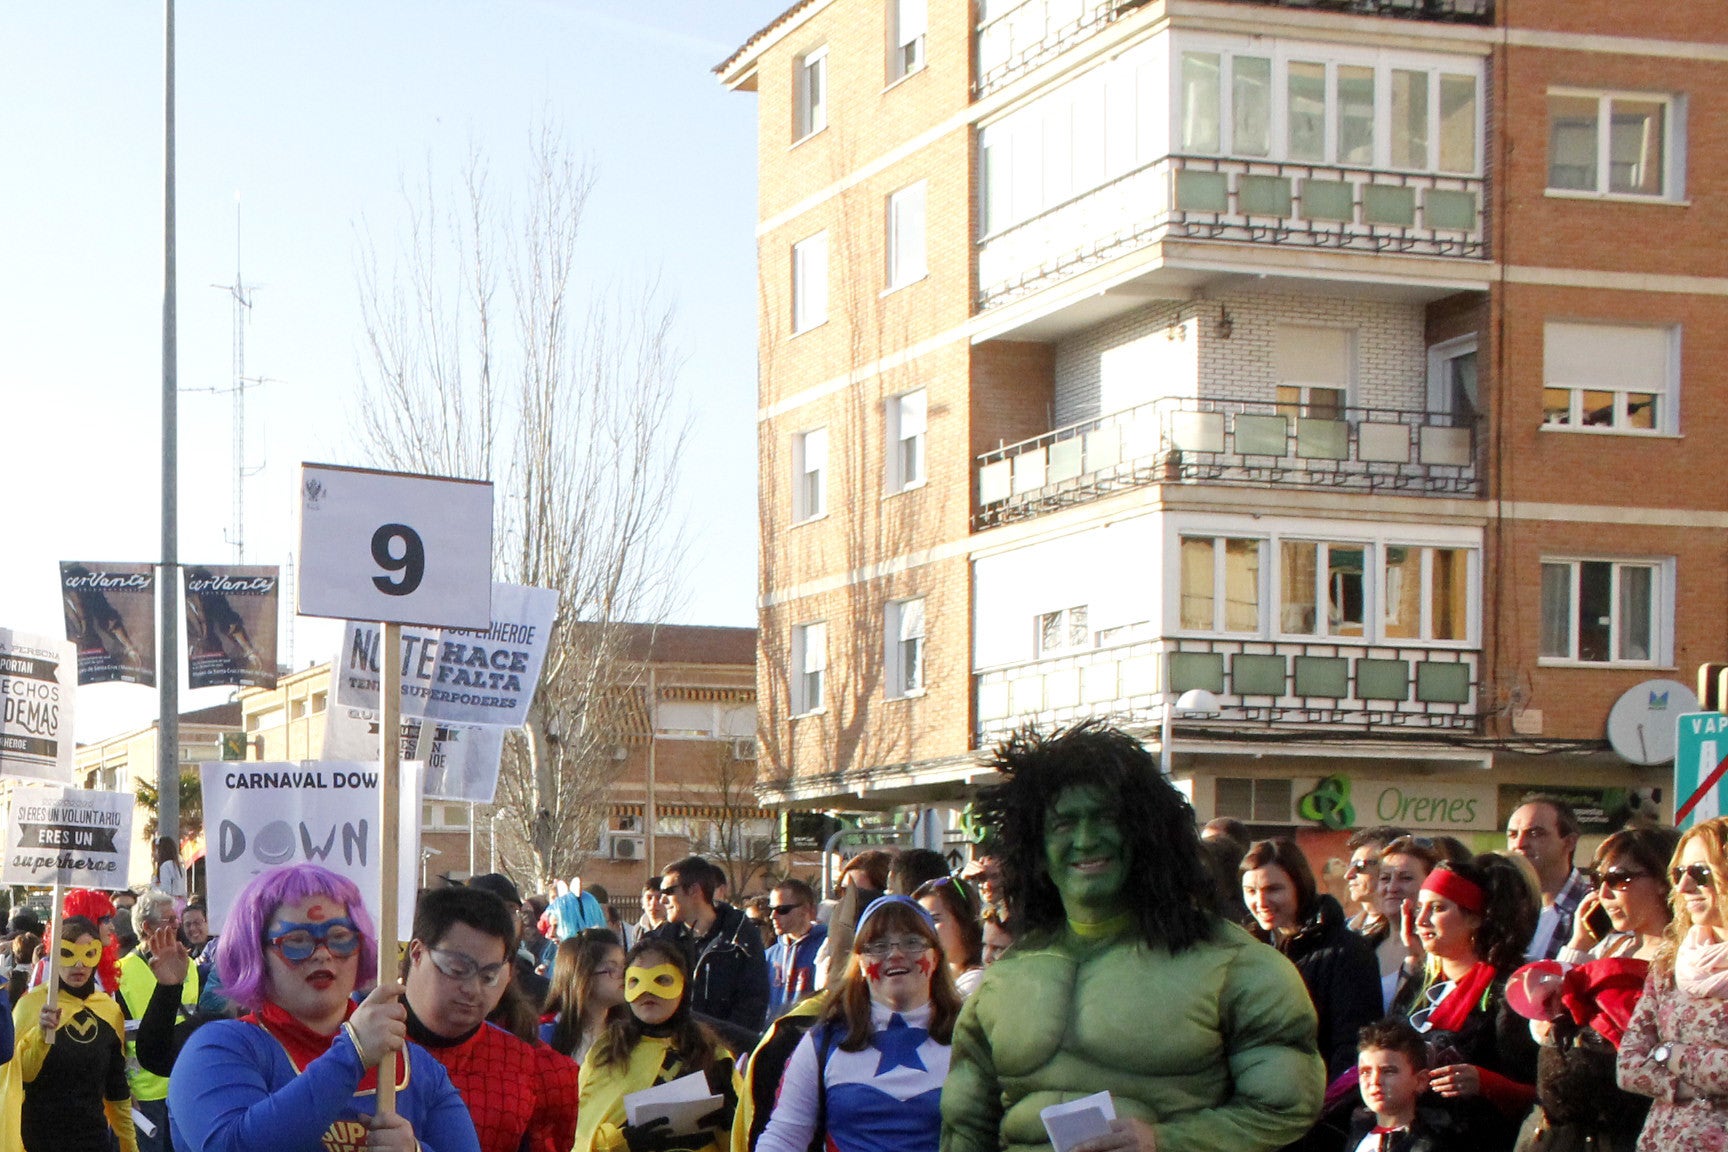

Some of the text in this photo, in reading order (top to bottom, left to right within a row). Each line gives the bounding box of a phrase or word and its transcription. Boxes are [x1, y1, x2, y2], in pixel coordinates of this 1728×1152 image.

[371, 523, 425, 596] 9
[11, 644, 60, 661] PERSONA
[401, 634, 439, 680] TE
[440, 641, 530, 674] HACE
[348, 676, 518, 709] TEN SUPERPODERES
[436, 665, 522, 692] FALTA
[3, 697, 60, 737] DEMAS
[225, 771, 378, 790] CARNAVAL DOW
[18, 806, 121, 827] SI ERES UN VOLUNTARIO
[1376, 787, 1477, 824] Orenes
[38, 829, 93, 846] ERES UN
[219, 818, 369, 867] DOWN
